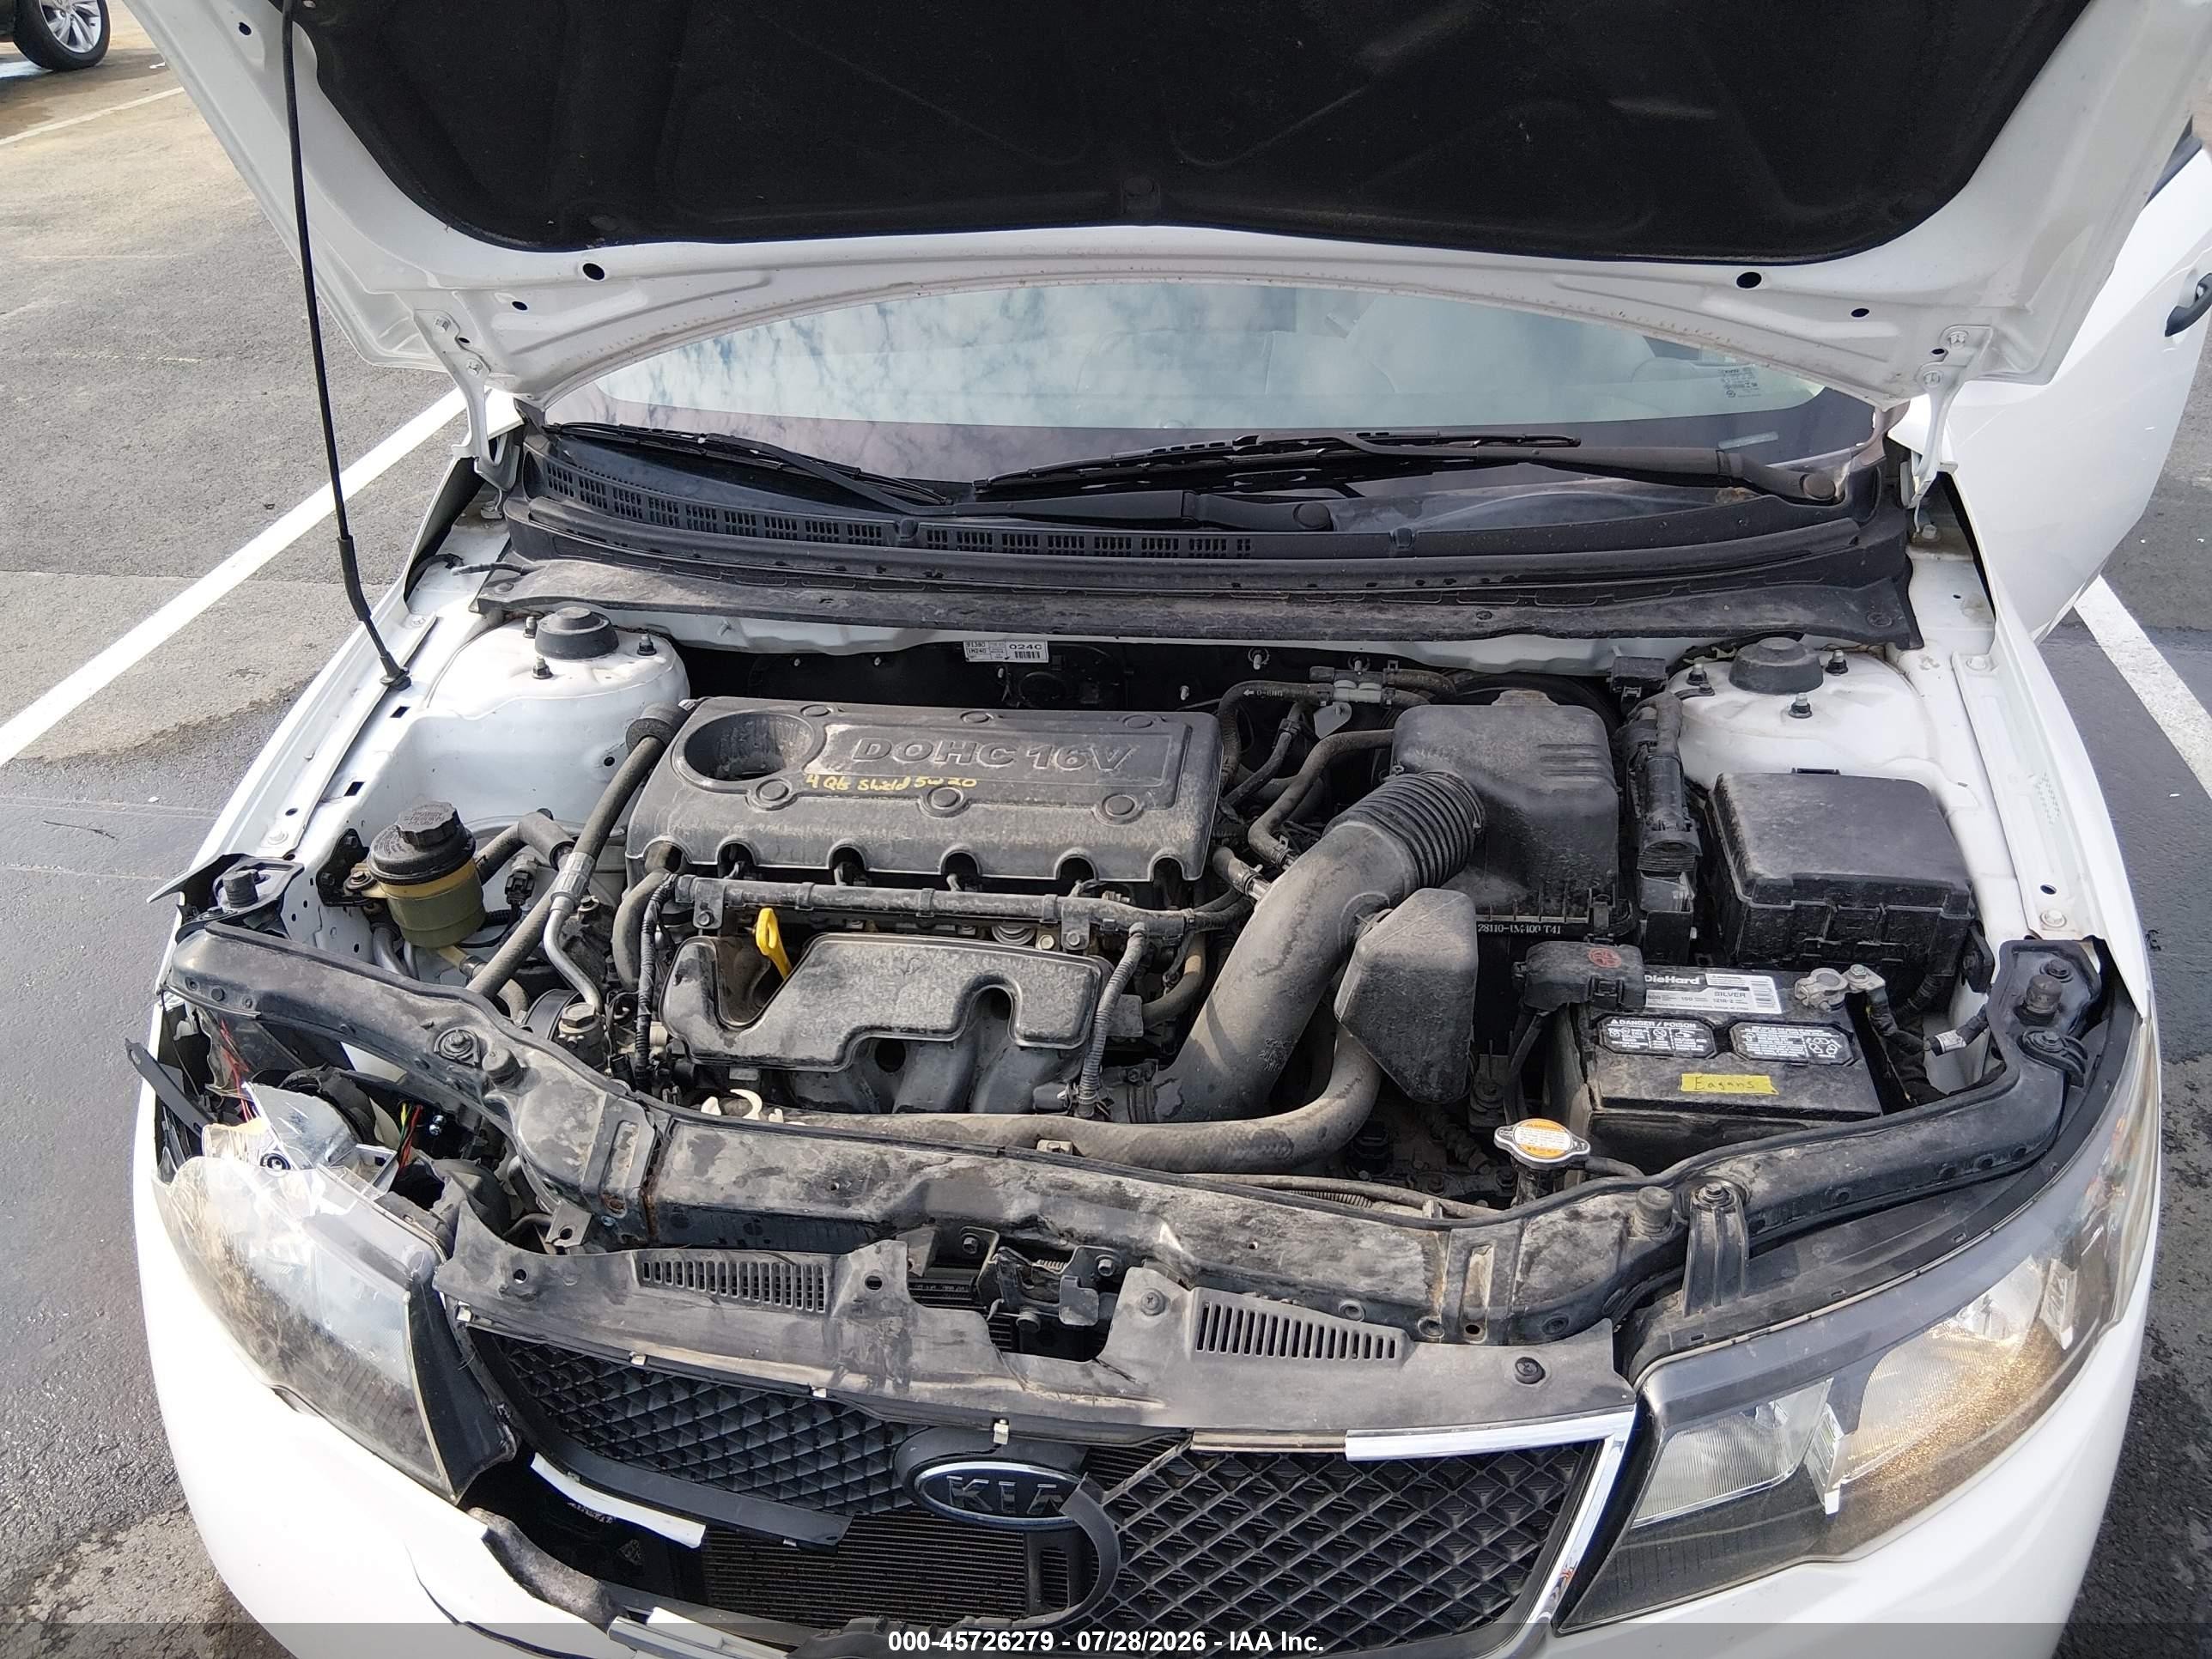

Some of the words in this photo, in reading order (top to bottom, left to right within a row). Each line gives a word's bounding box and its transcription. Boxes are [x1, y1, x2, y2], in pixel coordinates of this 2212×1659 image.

[853, 737, 1018, 768] DOHC
[1025, 744, 1133, 772] 16V
[805, 775, 819, 789] 4
[857, 775, 912, 792] Shield
[1644, 974, 1700, 985] DieHard
[946, 1475, 1065, 1516] KIA
